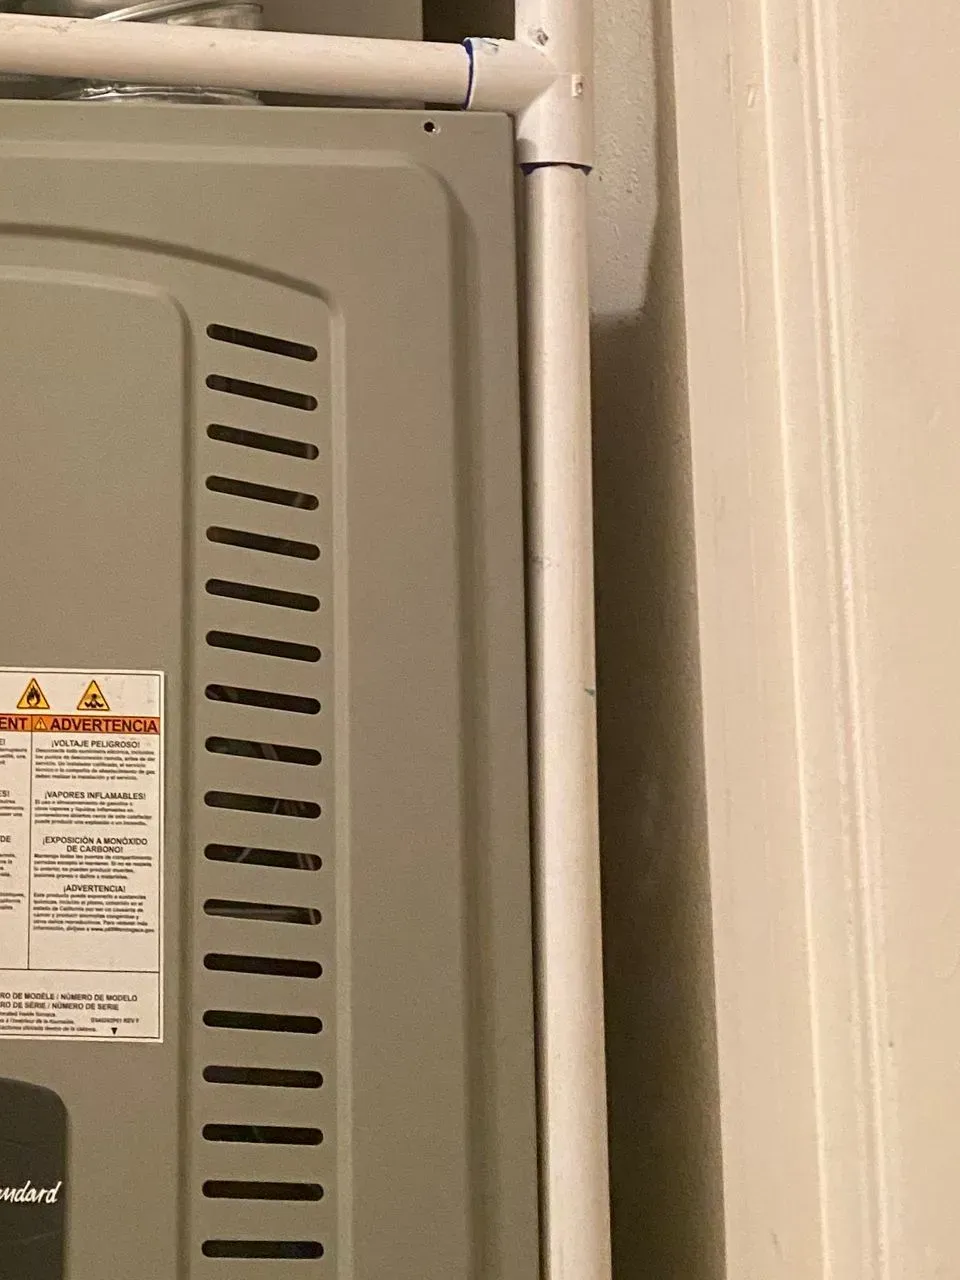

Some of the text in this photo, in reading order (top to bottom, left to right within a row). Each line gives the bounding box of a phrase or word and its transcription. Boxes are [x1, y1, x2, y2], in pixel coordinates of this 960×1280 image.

[50, 718, 158, 733] ADVERTENCIA
[51, 740, 140, 748] ¡VOLTAJE PELIGROSO!
[45, 791, 146, 800] ¡VAPORES INFLAMABLES!
[103, 836, 148, 845] MONÓXIDO
[80, 845, 123, 853] CARBONO!
[64, 884, 125, 892] ¡ADVERTENCIA!
[106, 994, 138, 1002] MODELO
[97, 1003, 119, 1011] SERIE
